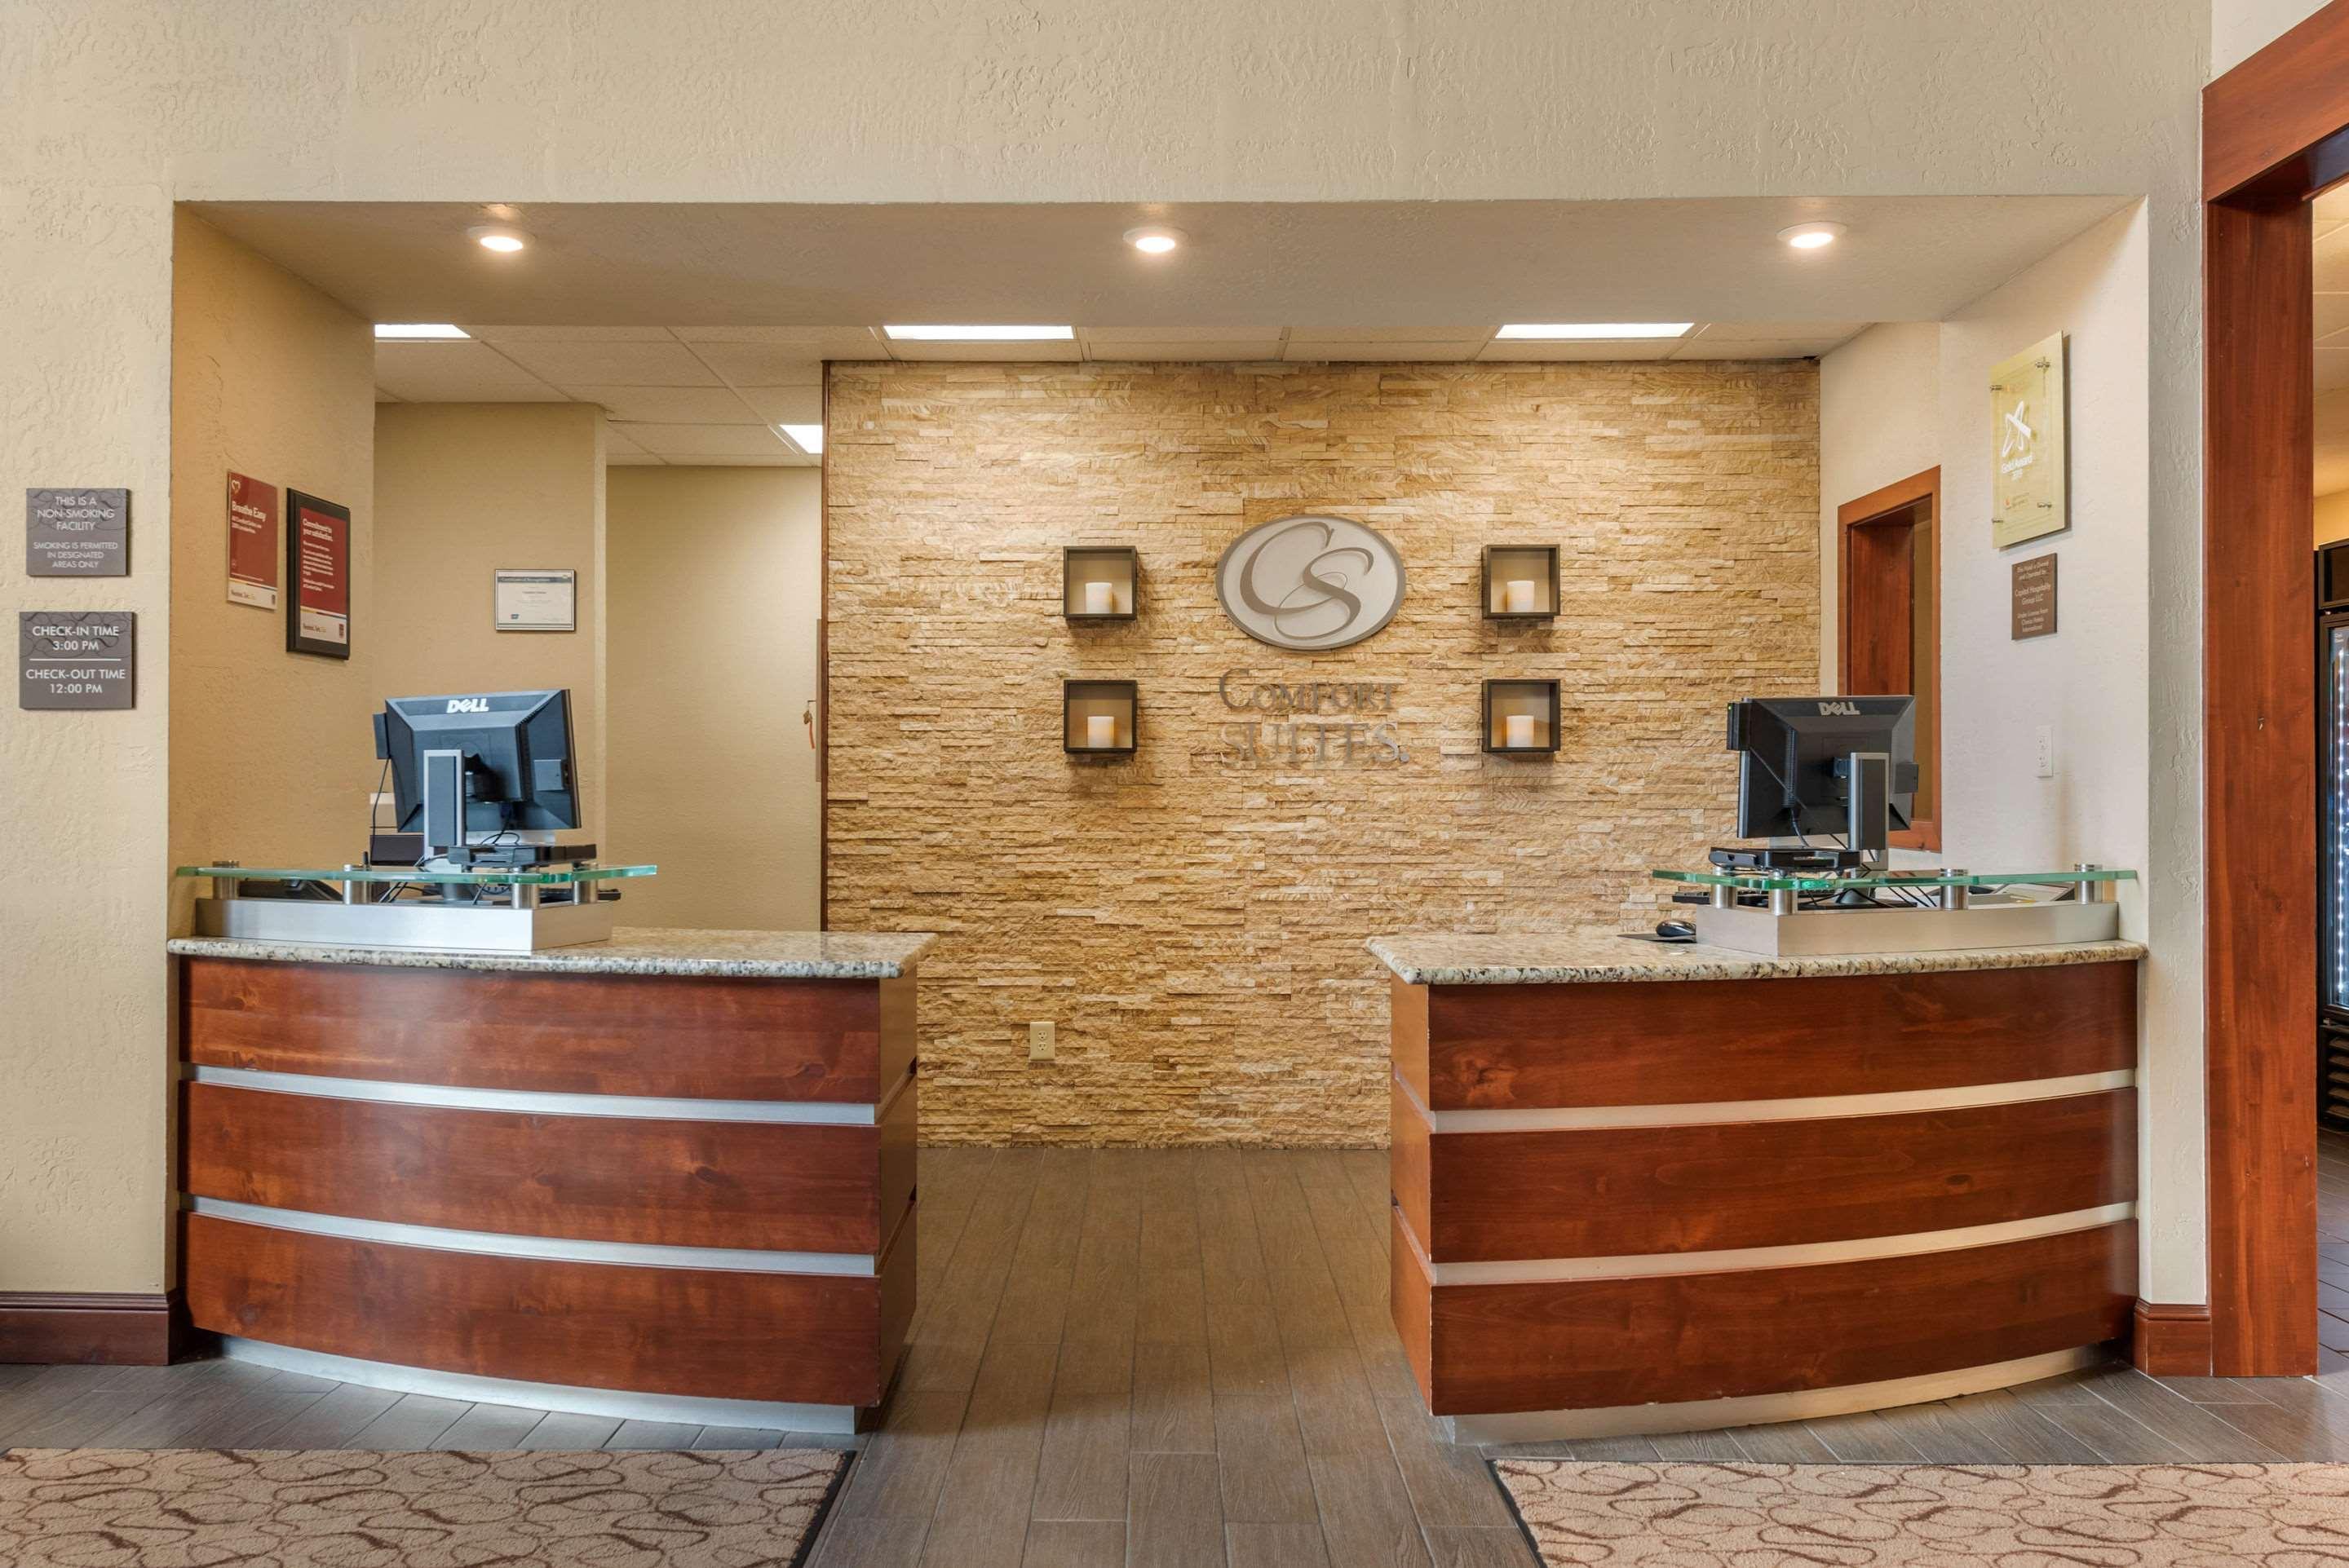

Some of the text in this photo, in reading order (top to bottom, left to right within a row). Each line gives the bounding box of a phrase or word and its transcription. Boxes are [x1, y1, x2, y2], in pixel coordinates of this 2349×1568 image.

[55, 496, 97, 506] THIS IS A
[37, 509, 115, 519] NON-SMOKING
[253, 506, 267, 522] Easy
[56, 521, 95, 531] FACILITY
[33, 541, 118, 550] SMOKING IS PERMITTED
[51, 560, 99, 568] AREAS ONLY
[33, 625, 119, 636] CHECK-IN TIME
[52, 640, 99, 651] 3:00 PM
[26, 669, 126, 679] CHECK-OUT TIME
[50, 683, 103, 694] 12:00 PM
[446, 698, 489, 713] DELL
[1818, 701, 1860, 716] DELL
